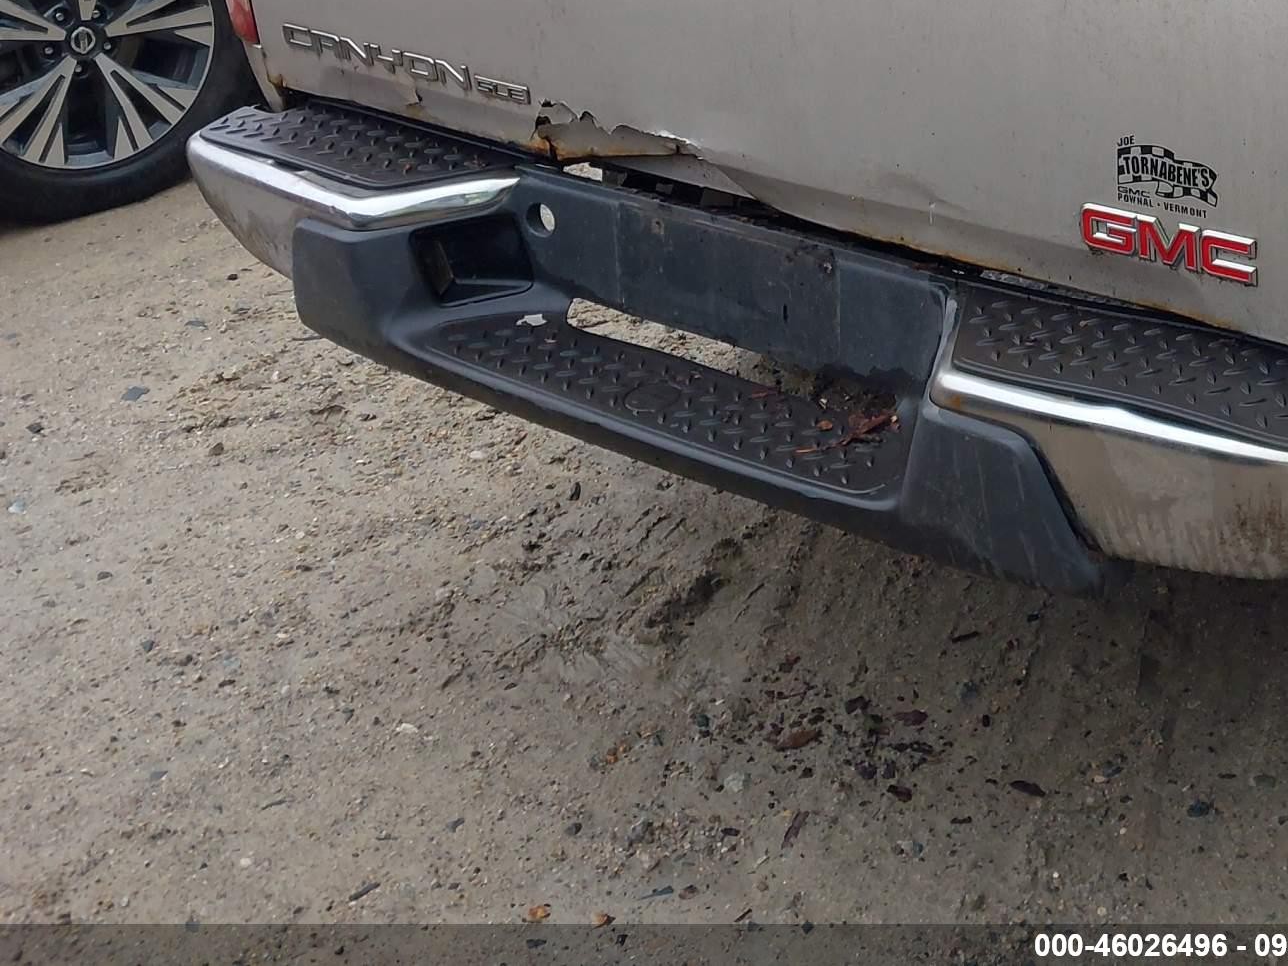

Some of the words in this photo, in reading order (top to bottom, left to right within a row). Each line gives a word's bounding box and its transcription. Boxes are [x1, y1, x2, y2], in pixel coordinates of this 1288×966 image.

[282, 21, 473, 91] CANYON
[1117, 135, 1135, 146] JOE
[1123, 154, 1210, 188] TORNABENE'S
[1117, 186, 1151, 198] GMC
[1117, 193, 1154, 208] POWNAL
[1164, 202, 1208, 219] VERMONT
[1080, 202, 1258, 287] GMC
